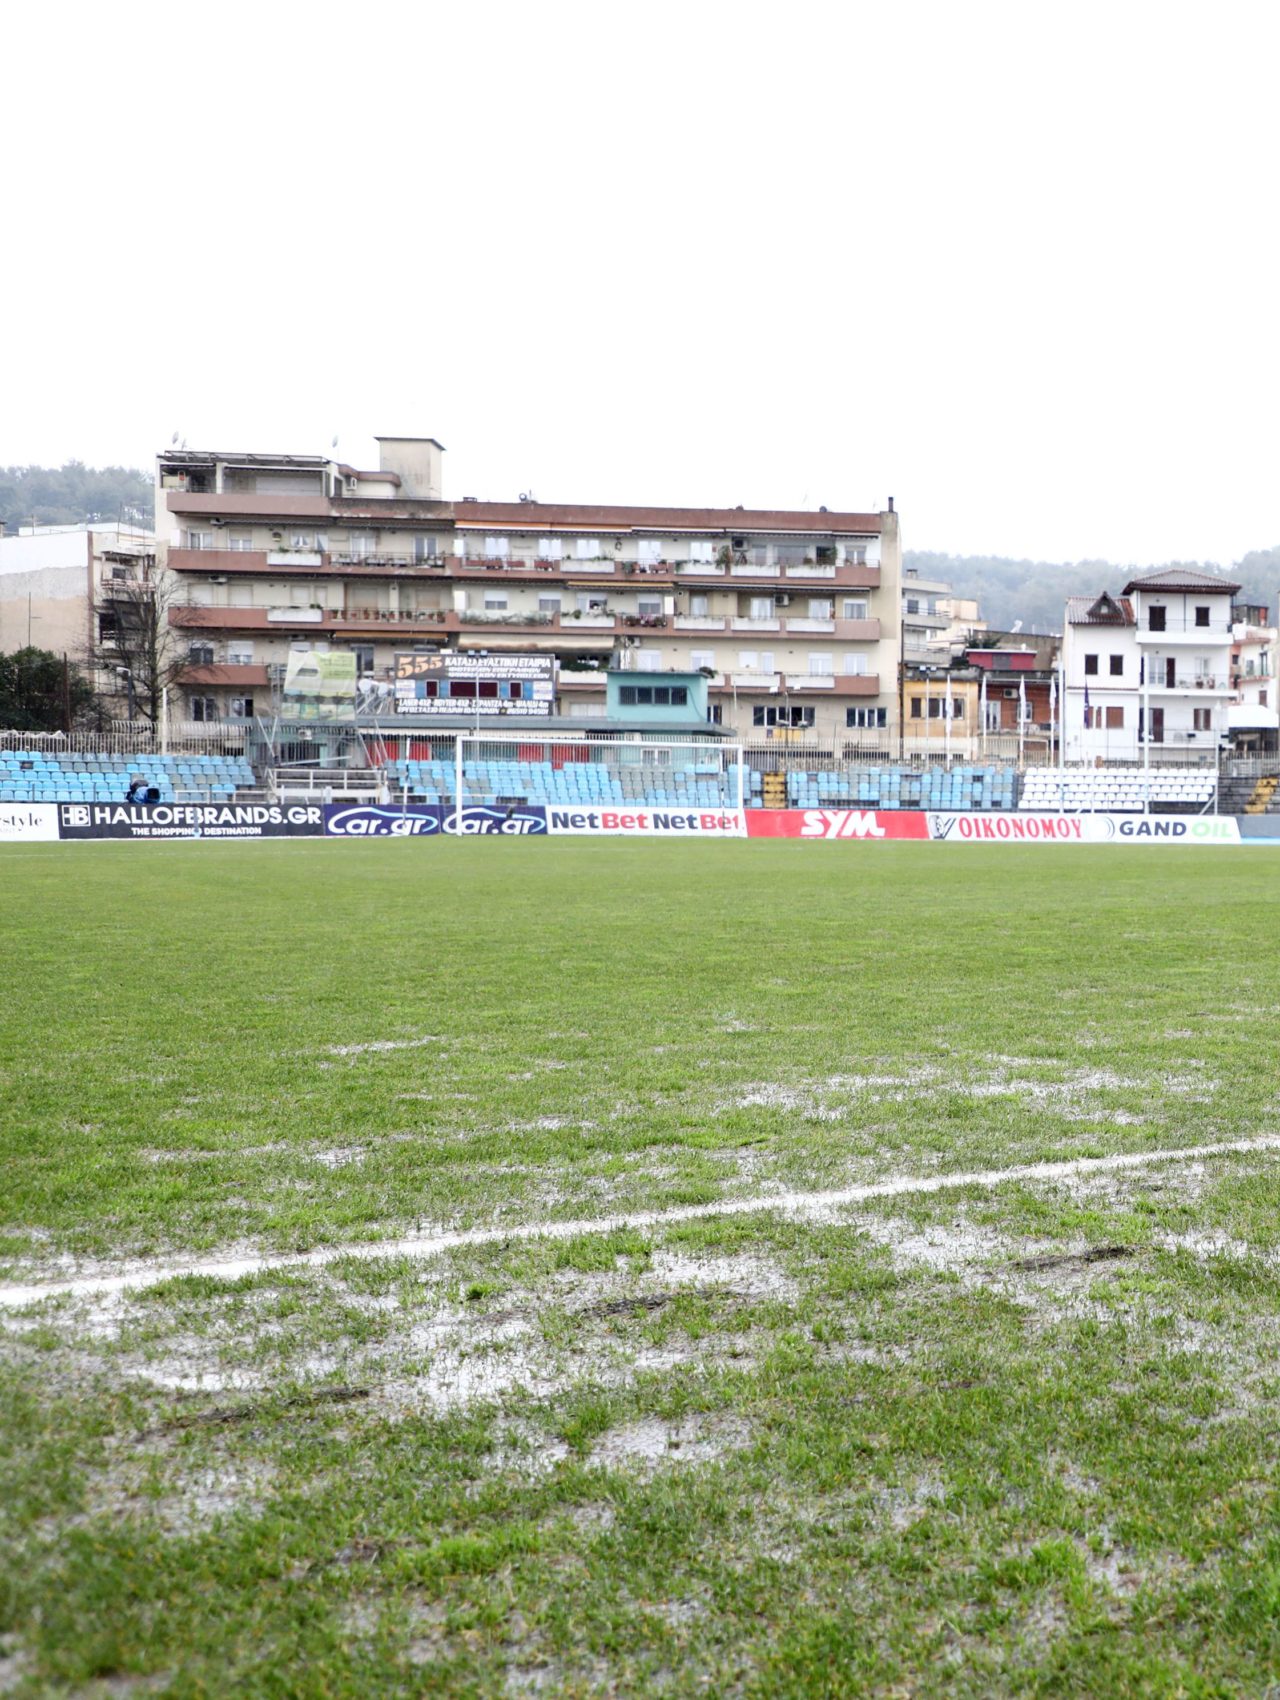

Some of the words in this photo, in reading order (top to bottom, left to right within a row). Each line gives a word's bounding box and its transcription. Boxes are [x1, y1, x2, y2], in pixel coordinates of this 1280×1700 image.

[397, 656, 443, 678] 555
[519, 657, 551, 668] ΕΤΑΙΡΙΑ
[0, 812, 42, 831] style
[95, 805, 322, 825] HALLOFBRANDS.GR
[551, 812, 649, 829] NetBet
[653, 813, 739, 830] NetBet
[131, 827, 150, 836] THE
[204, 826, 262, 836] DESTINATION
[801, 811, 886, 839] SYM
[958, 816, 1083, 839] OIKONOMOY
[1119, 820, 1187, 837] GAND
[1191, 821, 1233, 838] OIL
